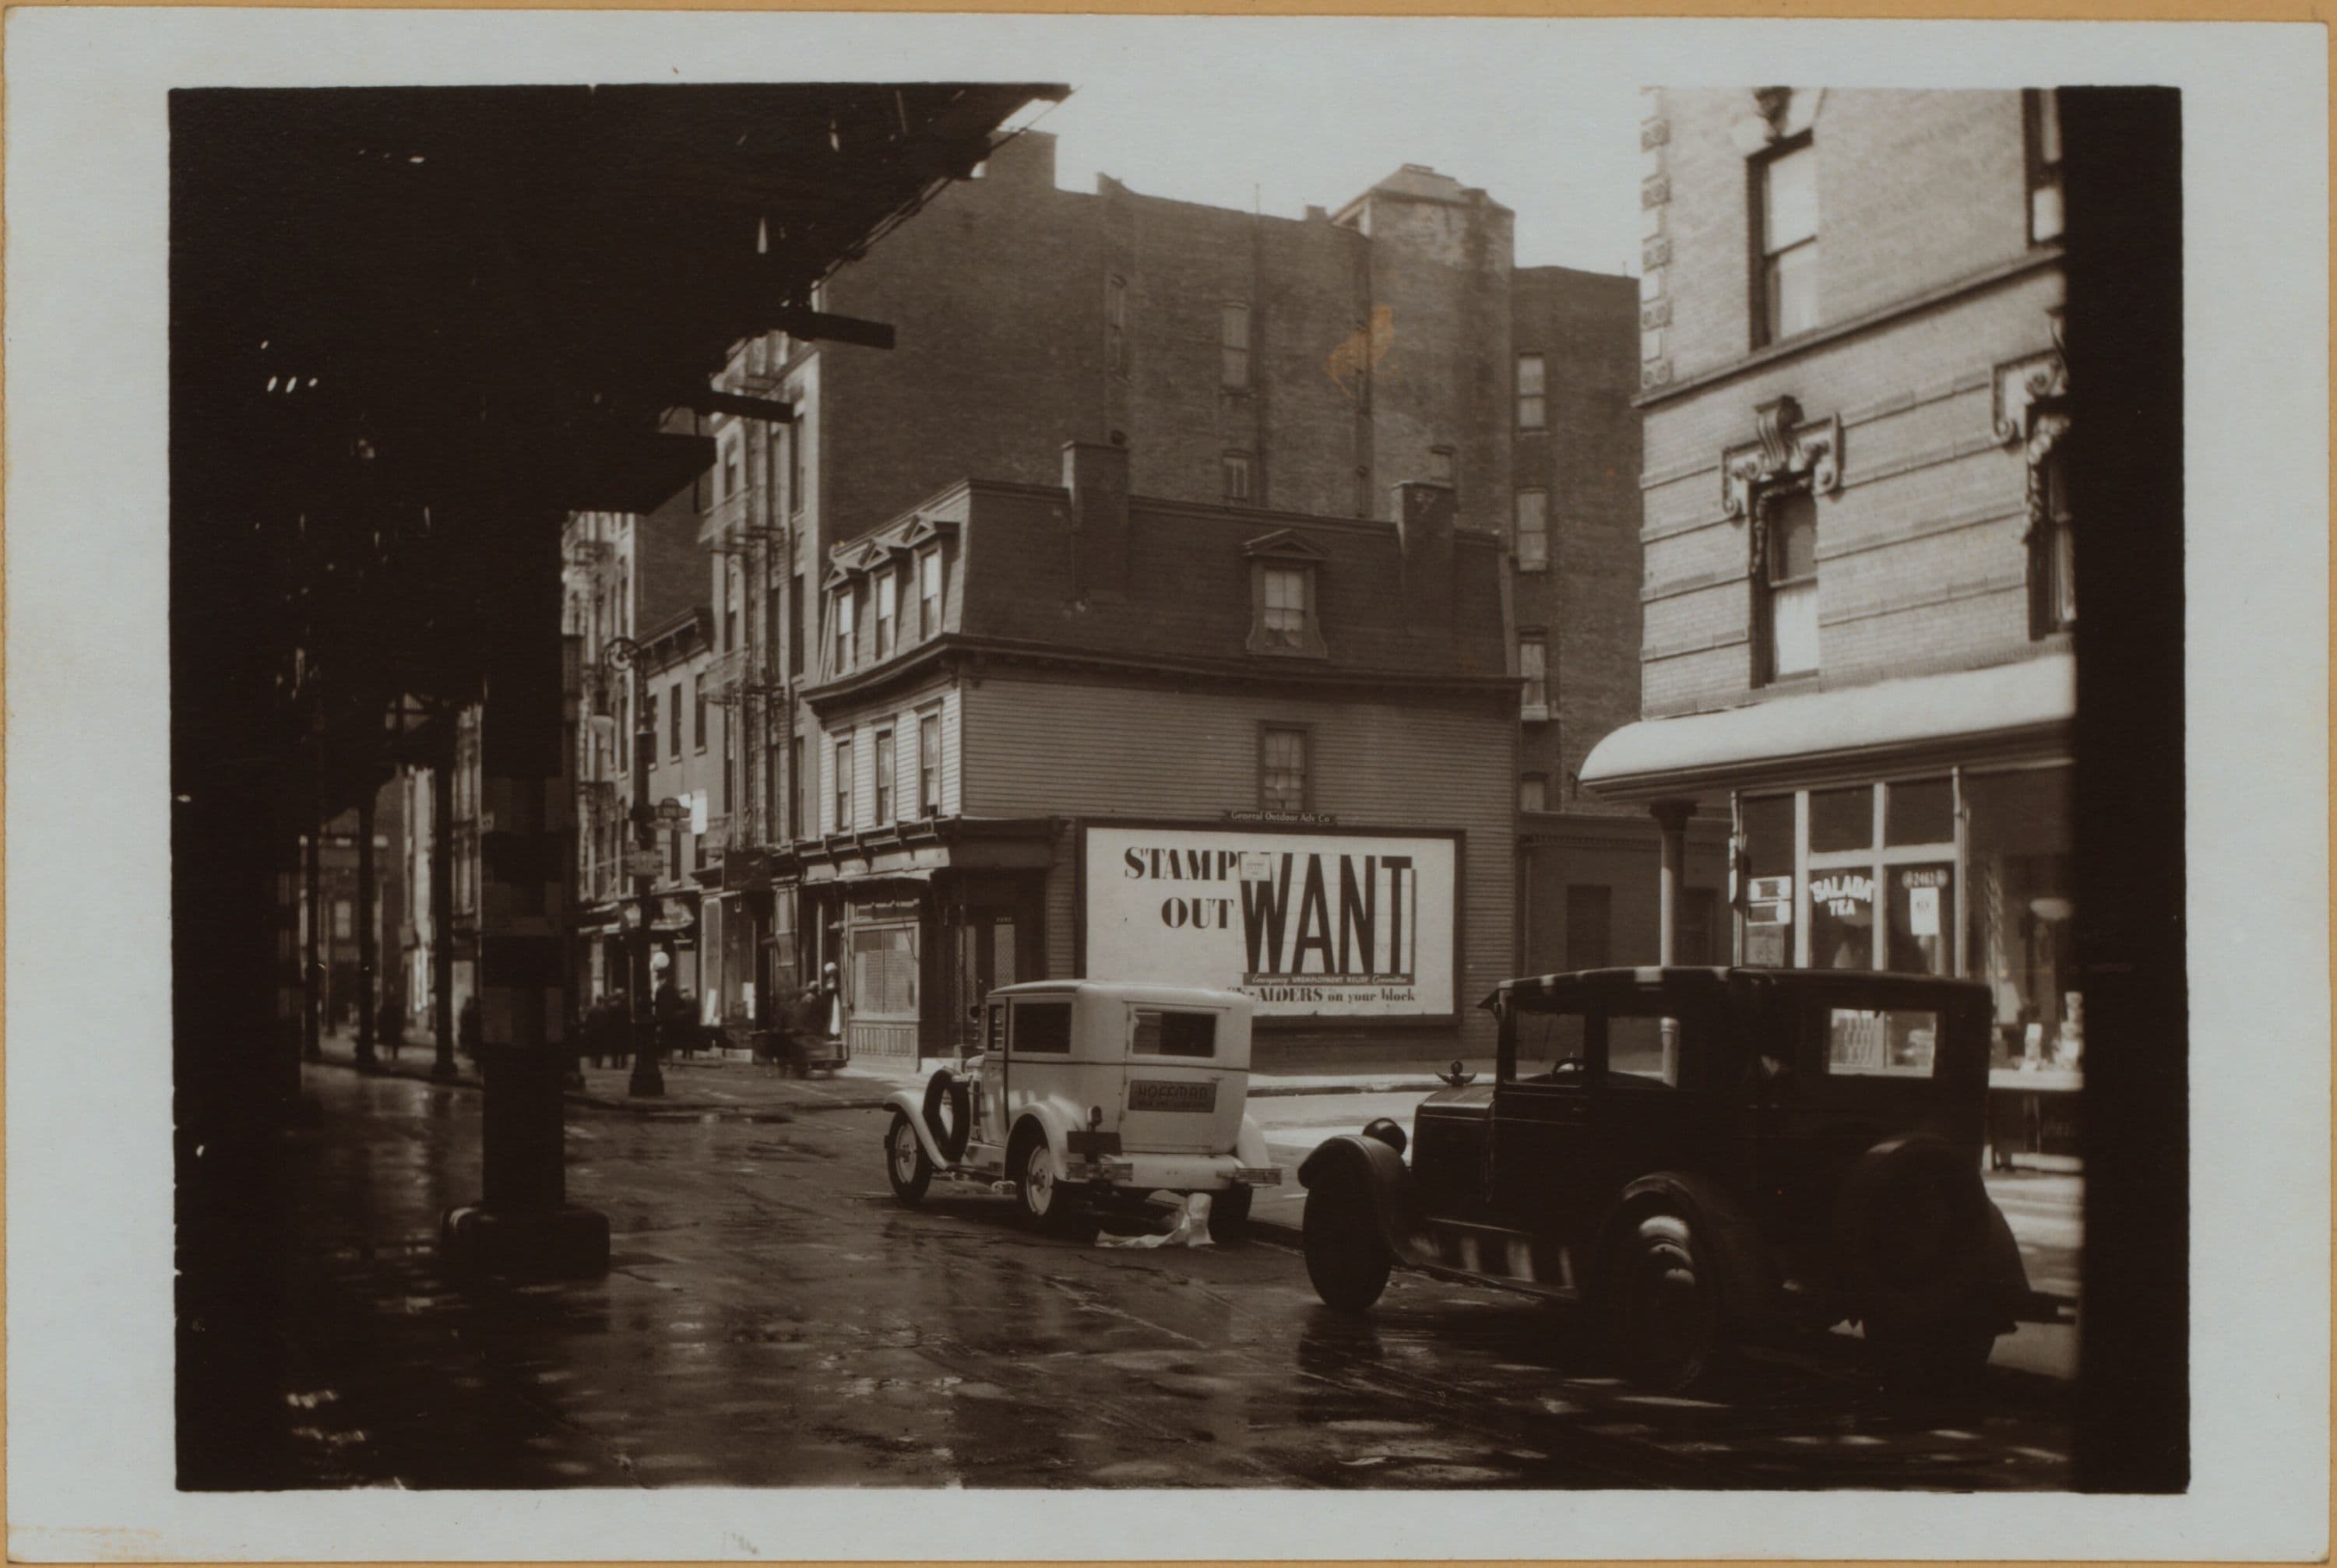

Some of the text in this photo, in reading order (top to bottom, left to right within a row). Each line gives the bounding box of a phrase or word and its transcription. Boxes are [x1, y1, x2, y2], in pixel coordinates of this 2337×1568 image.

[1230, 810, 1262, 821] General
[1265, 811, 1298, 822] Outdoor
[1125, 846, 1237, 881] STAMP
[1161, 897, 1234, 929] OUT
[1237, 852, 1414, 974] WANT
[1828, 899, 1856, 916] TEA
[1328, 991, 1343, 1001] on
[1348, 992, 1377, 1004] your
[1381, 987, 1416, 1001] block
